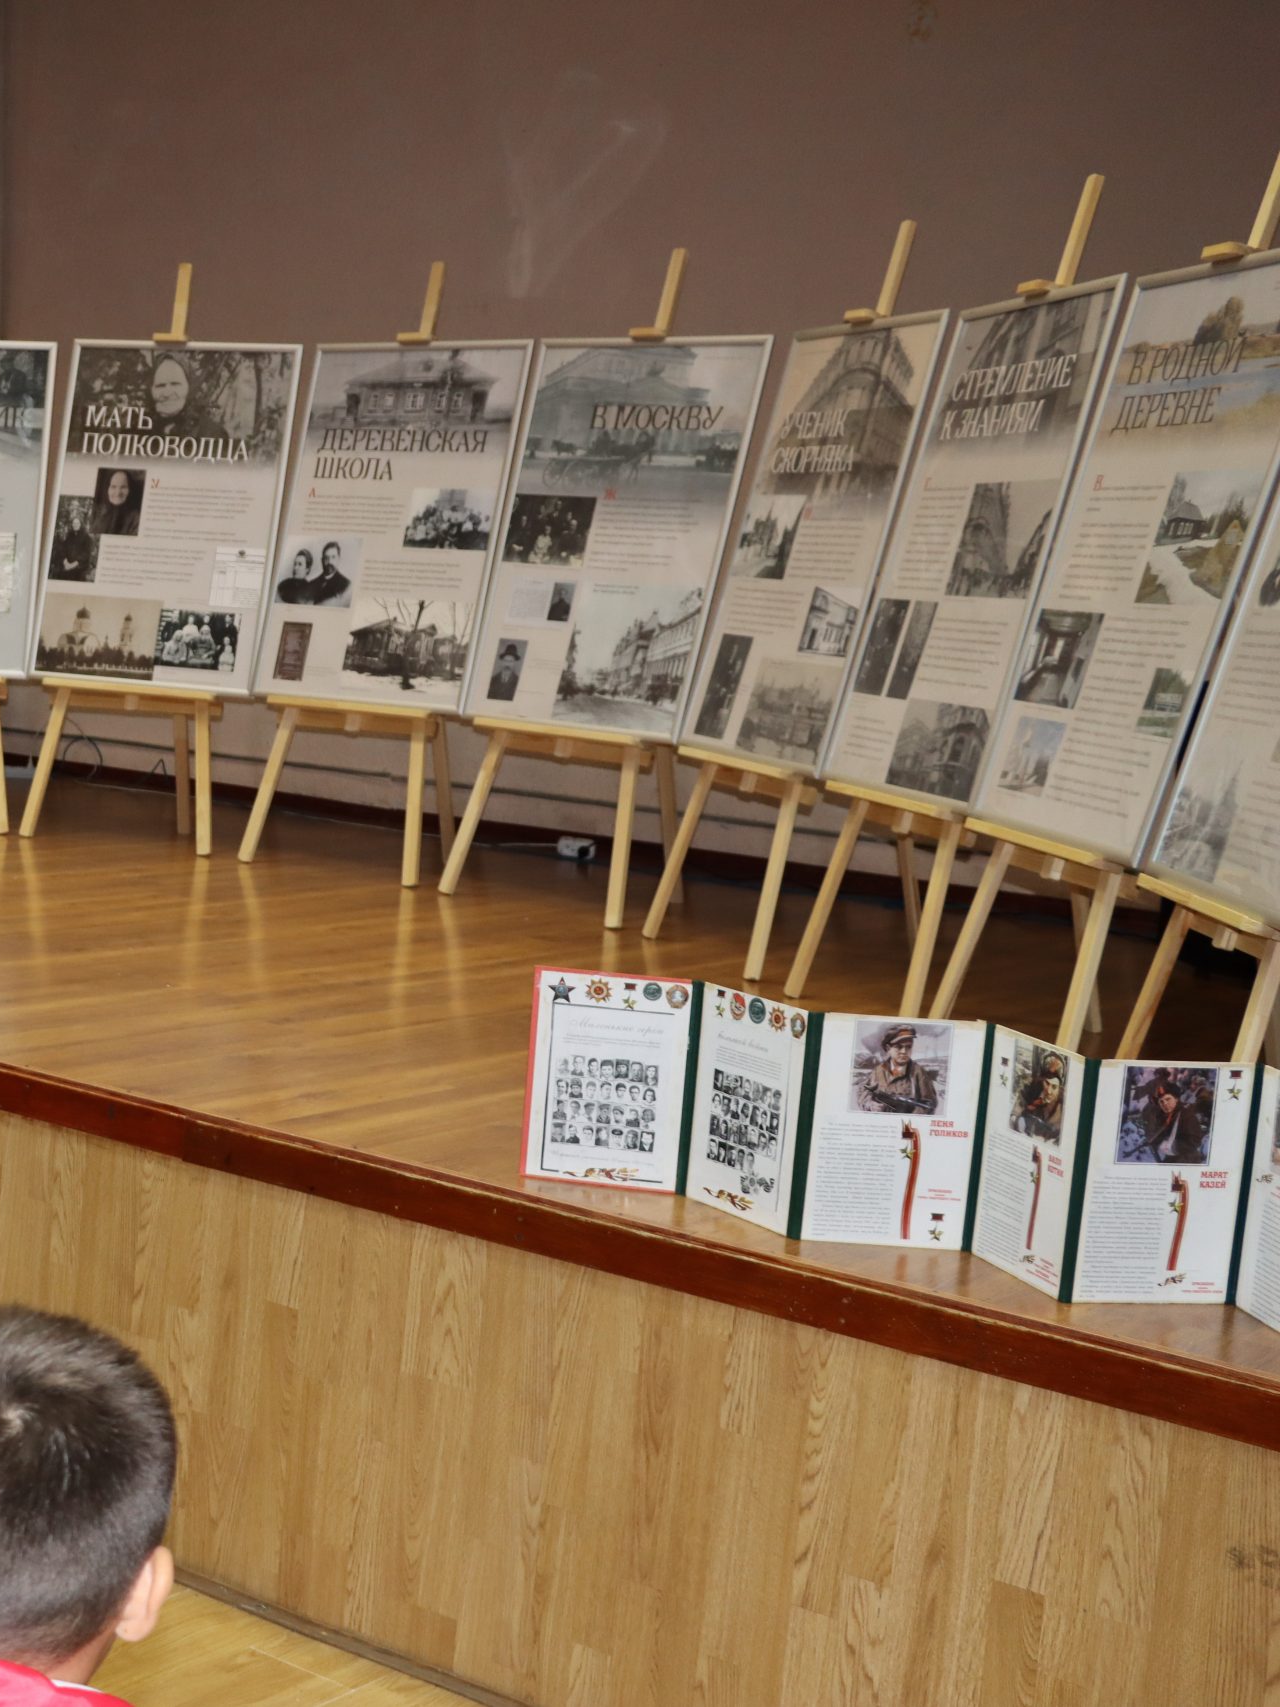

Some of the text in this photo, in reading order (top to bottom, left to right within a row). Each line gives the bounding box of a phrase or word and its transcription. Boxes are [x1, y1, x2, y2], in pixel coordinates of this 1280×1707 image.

[1127, 333, 1248, 386] В РОДНОЙ
[952, 354, 1077, 402] СТРЕМЛЕНИЕ
[85, 405, 152, 429] МАТЬ
[590, 403, 724, 431] В МОСКВУ
[781, 408, 850, 440] УЧЕНИК
[940, 399, 1046, 440] К ЗНАНИЯМ
[1109, 386, 1222, 437] ДЕРЕВНЕ
[82, 432, 249, 464] ПОЛКОВОДЦА
[317, 428, 488, 453] ДЕРЕВЕНСКАЯ
[313, 457, 392, 480] ШКОЛА
[771, 445, 854, 473] СКОРНЯКА
[1200, 1171, 1229, 1179] МАРАТ
